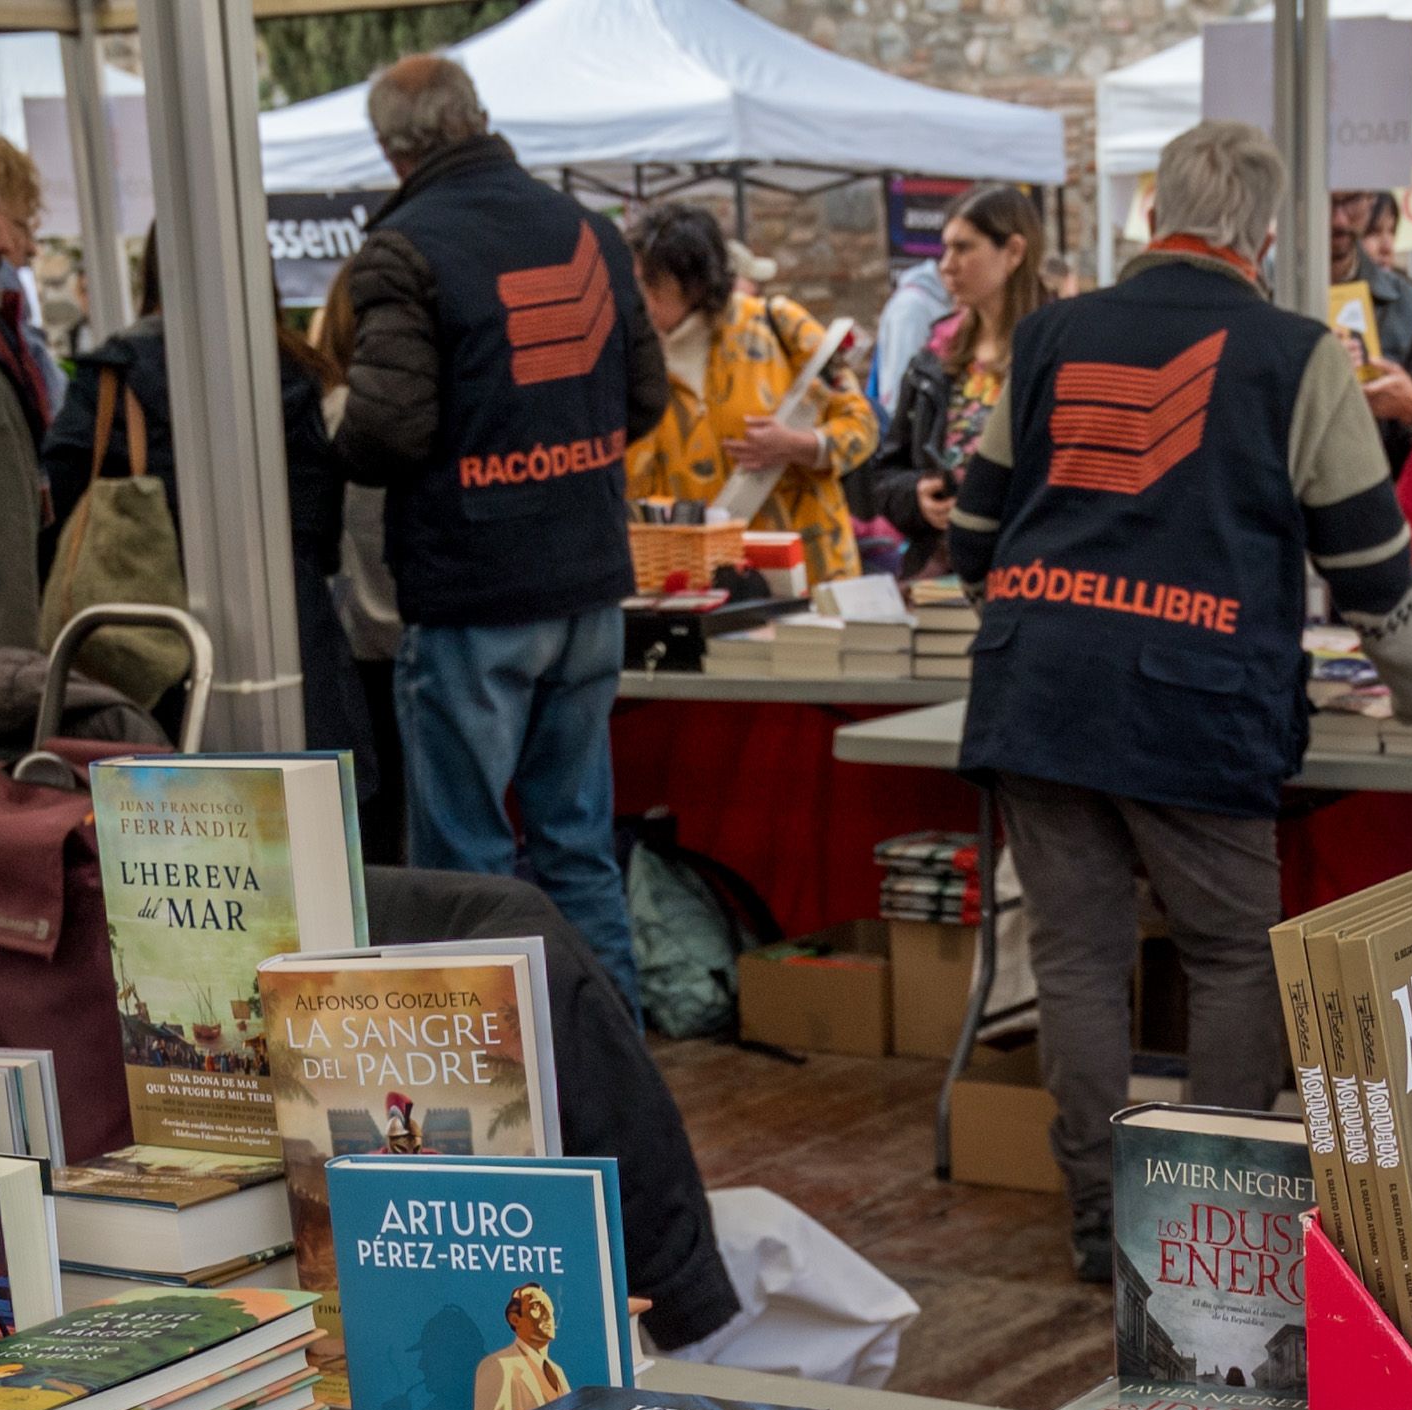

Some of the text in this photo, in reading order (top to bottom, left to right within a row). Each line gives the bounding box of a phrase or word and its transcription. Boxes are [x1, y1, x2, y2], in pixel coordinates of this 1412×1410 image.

[119, 801, 244, 816] JUAN FRANCISCO
[120, 818, 249, 839] FERRÁNDIZ
[120, 862, 261, 892] L'HEREVA
[167, 898, 248, 932] MAR
[295, 990, 482, 1011] ALFONSO GOIZUETA
[286, 1012, 502, 1049] LA SANGRE
[302, 1051, 492, 1086] DEL PADRE
[1144, 1157, 1219, 1191] JAVIER
[380, 1199, 534, 1239] ARTURO
[1157, 1204, 1292, 1254] LOS IDUS
[357, 1234, 565, 1274] PÉREZ-REVERTE
